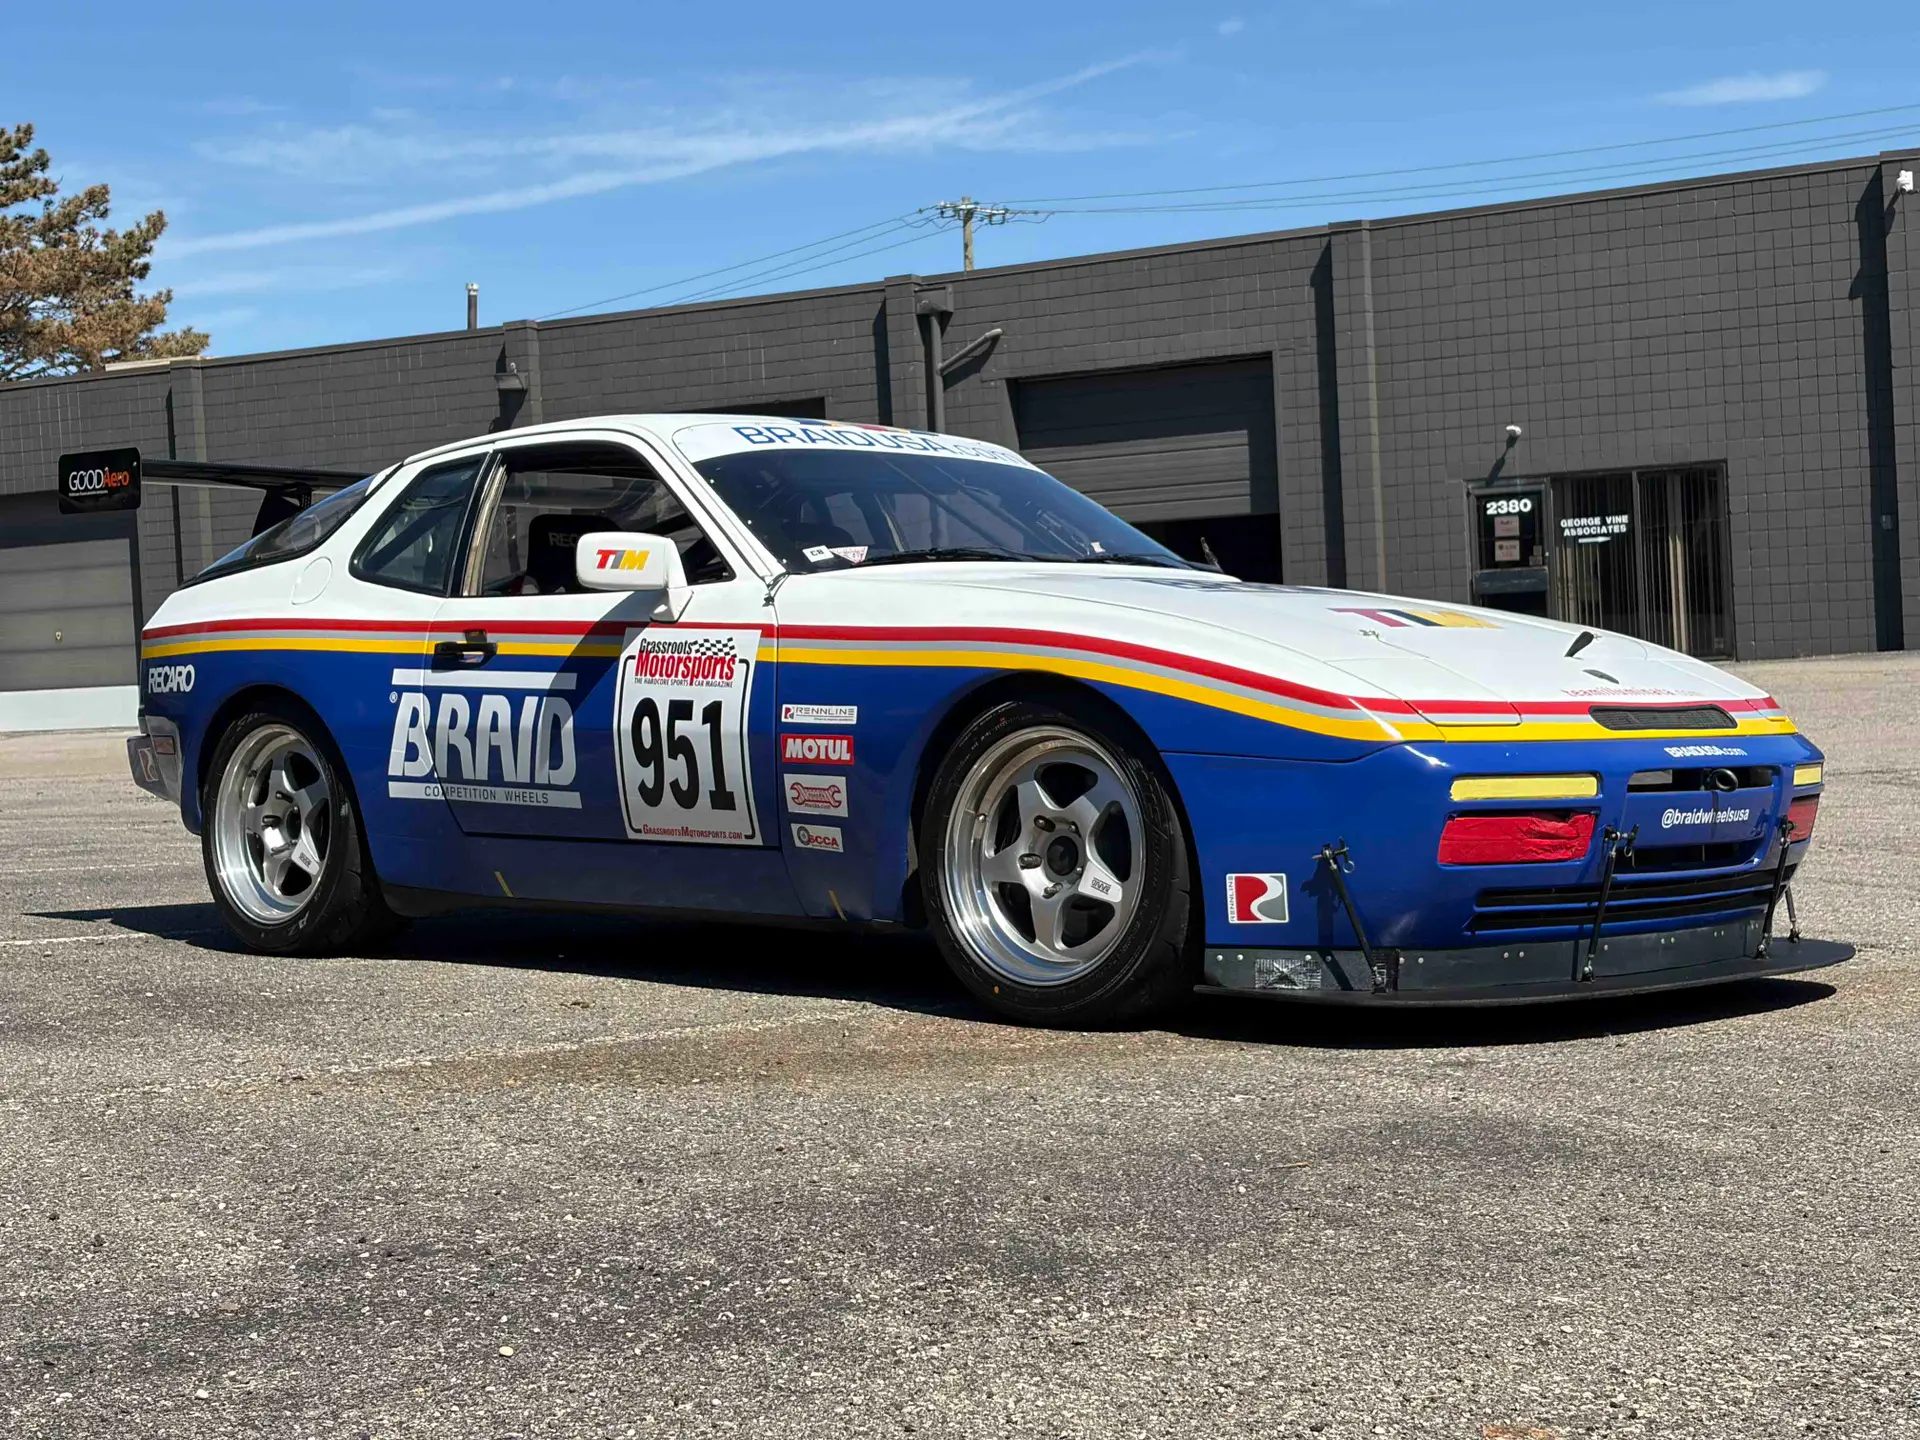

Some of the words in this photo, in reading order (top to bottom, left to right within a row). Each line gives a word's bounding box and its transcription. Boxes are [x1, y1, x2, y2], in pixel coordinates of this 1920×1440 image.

[1486, 498, 1532, 515] 2380
[1560, 516, 1601, 528] GEORGE
[1605, 514, 1629, 524] VINE
[1563, 524, 1627, 537] ASSOCIATES
[596, 549, 650, 570] TIM
[640, 638, 693, 655] Grassroots
[635, 650, 737, 686] Motorsports
[148, 664, 195, 694] RECARO
[634, 677, 643, 685] THE
[644, 678, 669, 686] HARDCORE
[670, 679, 689, 687] SPORTS
[705, 680, 733, 688] MAGAZINE
[796, 706, 855, 716] RENNLINE
[387, 692, 577, 786] BRAID
[631, 697, 737, 811] 951
[785, 738, 851, 760] MOTUL
[1663, 745, 1748, 758] BRAIDUSA.com
[424, 785, 497, 801] COMPETITION
[504, 791, 549, 804] WHEELS
[1661, 807, 1750, 829] @braidwheelsusa
[808, 835, 840, 847] SCCA
[1228, 875, 1236, 922] RENNLINE
